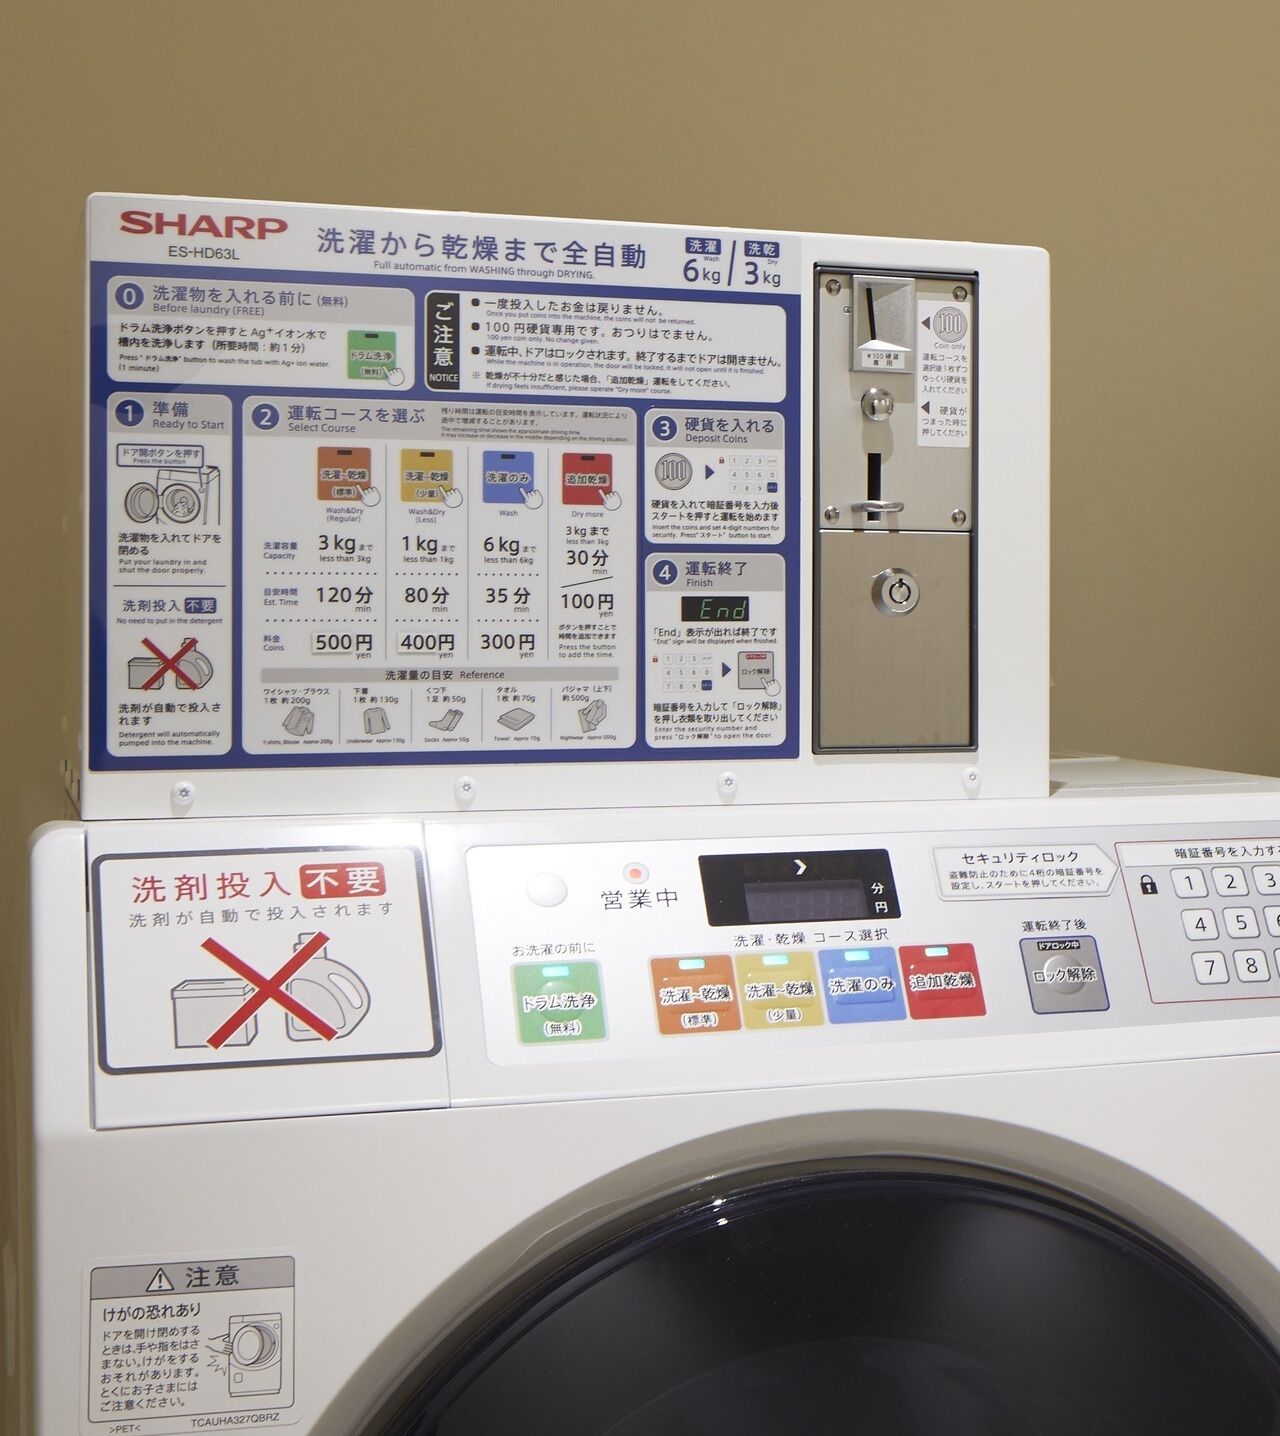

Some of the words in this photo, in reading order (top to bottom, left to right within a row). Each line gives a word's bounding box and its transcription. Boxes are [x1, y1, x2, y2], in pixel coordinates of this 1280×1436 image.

[120, 210, 288, 240] SHARP
[168, 246, 240, 260] ES-HD63L
[317, 226, 646, 270] 洗濯から乾燥まで全自動
[690, 239, 717, 254] 洗濯
[749, 242, 776, 256] 洗乾
[374, 261, 390, 269] Full
[393, 262, 441, 272] automatic
[444, 264, 466, 273] from
[469, 266, 514, 275] WASHING
[517, 268, 554, 278] through
[558, 270, 595, 279] DRYING.
[153, 285, 312, 306] 洗濯物を入れる前に
[153, 303, 187, 314] Before
[191, 305, 229, 317] laundry
[232, 305, 264, 317] (FREE)
[484, 299, 664, 316] 一度投入したお金は戻りません。
[951, 343, 966, 351] only
[430, 373, 458, 382] NOTICE
[152, 402, 188, 418] 準備
[288, 405, 425, 423] 運転コースを選ぶ
[153, 419, 188, 431] Ready
[188, 420, 198, 429] to
[201, 420, 224, 430] Start
[289, 423, 318, 433] Select
[321, 423, 356, 433] Course
[685, 417, 775, 433] 硬貨を入れる
[686, 434, 720, 445] Deposit
[723, 435, 747, 443] Coins
[685, 560, 747, 577] 運転終了
[686, 578, 713, 587] Finish
[317, 587, 373, 603] 120分
[562, 593, 614, 610] 100円
[122, 598, 180, 612] 洗剤投入
[187, 599, 214, 612] 不要
[700, 599, 746, 619] End
[316, 634, 373, 651] 500円
[401, 632, 455, 652] 400円
[480, 633, 535, 651] 300円
[460, 670, 505, 679] Reference
[962, 850, 1079, 864] セキュリティロック
[132, 871, 292, 904] 洗剤投入
[305, 865, 381, 895] 不要
[871, 882, 885, 895] 分
[1186, 875, 1193, 891] 1
[1225, 874, 1237, 890] 2
[1265, 872, 1276, 888] 3
[601, 888, 678, 910] 営業中
[875, 901, 888, 913] 円
[128, 901, 393, 928] 洗剤が自動で投入されます
[1022, 919, 1087, 932] 運転終了後
[1195, 916, 1207, 932] 4
[1236, 915, 1247, 930] 5
[814, 929, 889, 943] コース選択
[512, 941, 596, 957] お洗濯の前に
[1204, 959, 1215, 975] 7
[1246, 958, 1258, 974] 8
[910, 972, 975, 990] 追加乾燥
[1034, 968, 1097, 984] ロック解除
[830, 977, 896, 994] 洗濯のみ
[523, 994, 596, 1012] ドラム洗浄
[185, 1265, 239, 1288] 注意
[103, 1303, 200, 1322] けがの恐れあり
[103, 1326, 200, 1340] ドアを開け閉めする
[192, 1413, 279, 1428] TCAUHA327QBRZ
